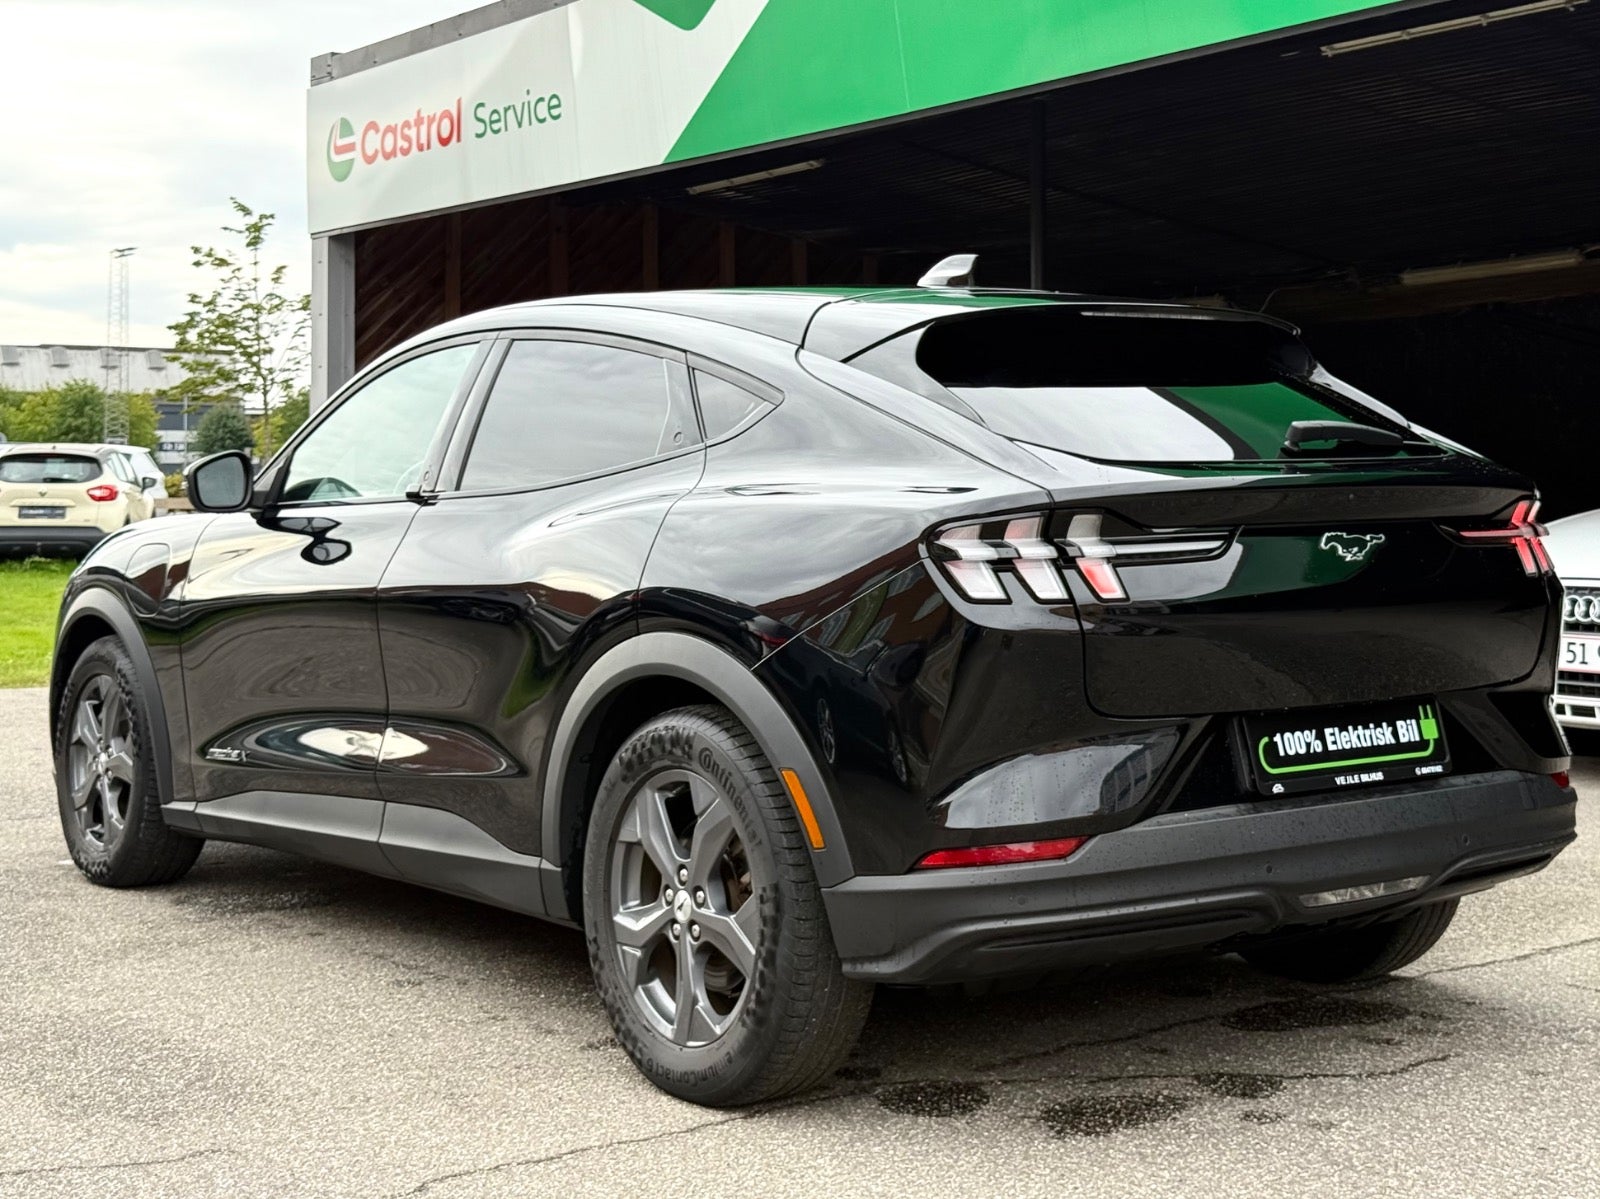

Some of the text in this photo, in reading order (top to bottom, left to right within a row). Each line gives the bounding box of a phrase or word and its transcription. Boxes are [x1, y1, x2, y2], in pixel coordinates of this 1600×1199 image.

[361, 89, 562, 166] Castrol Service
[1566, 642, 1588, 665] 51
[1273, 718, 1420, 757] 100% Elektrisk Bil
